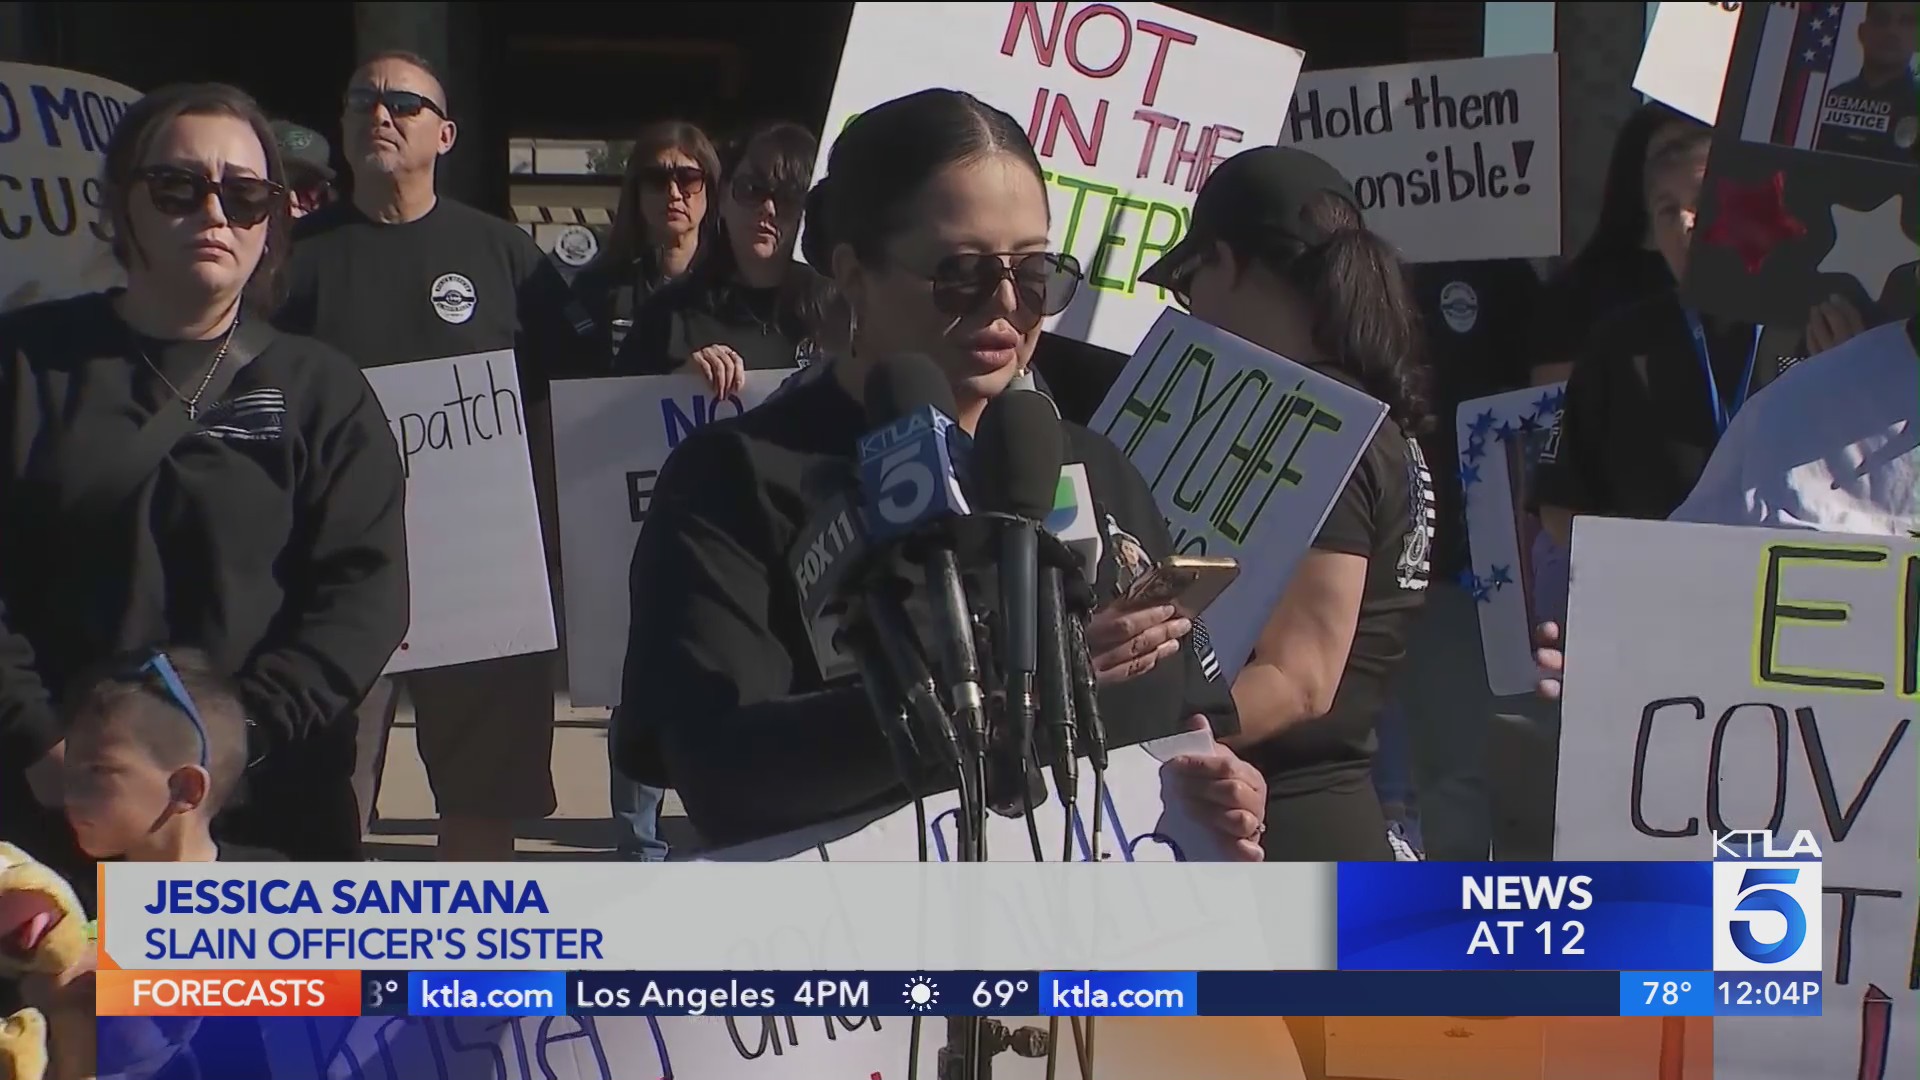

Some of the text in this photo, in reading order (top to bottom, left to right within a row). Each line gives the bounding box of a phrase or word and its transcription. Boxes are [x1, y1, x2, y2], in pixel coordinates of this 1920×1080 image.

[1001, 1, 1197, 106] NOT
[1028, 87, 1109, 167] IN
[1289, 75, 1519, 143] Hold them
[1824, 110, 1887, 129] JUSTICE
[1826, 95, 1891, 115] DEMAND
[388, 361, 522, 478] patch
[860, 414, 931, 458] KTLA
[878, 440, 936, 524] 5
[795, 511, 856, 601] FOX 11
